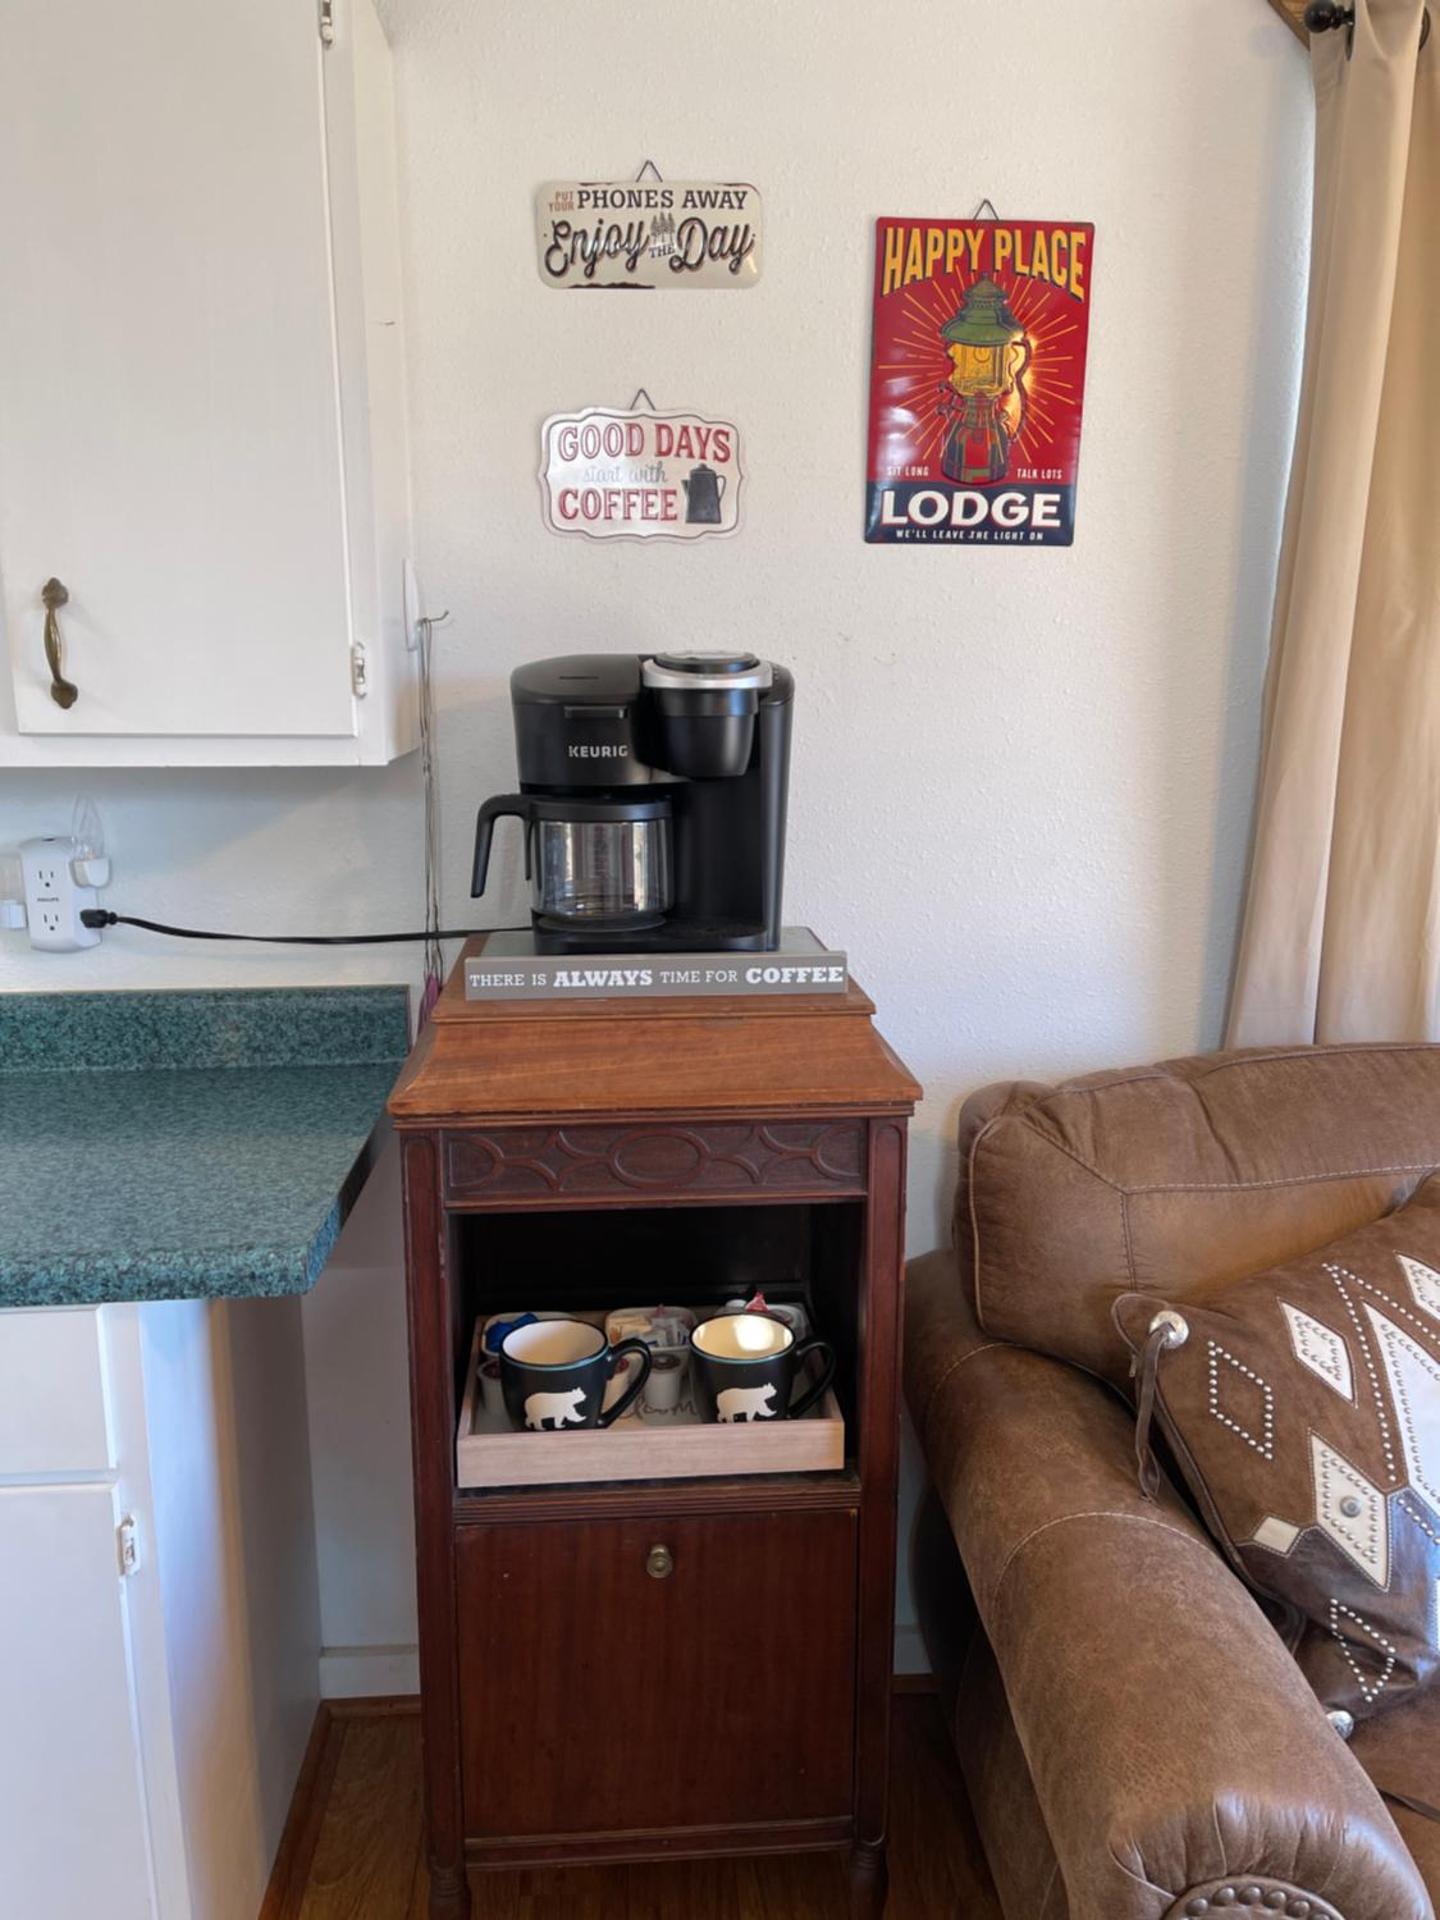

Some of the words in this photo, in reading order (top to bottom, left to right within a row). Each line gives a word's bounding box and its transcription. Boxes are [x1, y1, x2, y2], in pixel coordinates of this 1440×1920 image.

[548, 201, 575, 213] YOUR
[555, 191, 573, 201] PUT
[577, 189, 674, 209] PHONES
[681, 190, 748, 210] AWAY
[544, 218, 650, 279] Enjoy
[650, 245, 676, 258] THE
[668, 217, 756, 275] Day
[882, 226, 985, 297] HAPPY
[992, 228, 1087, 303] PLACE
[558, 422, 645, 462] GOOD
[654, 423, 732, 464] DAYS
[582, 464, 623, 484] start
[628, 461, 669, 484] with
[904, 466, 930, 477] LONG
[1016, 467, 1038, 479] TALK
[1041, 468, 1063, 480] LOTS
[559, 487, 679, 522] COFFEE
[880, 489, 1062, 528] LODGE
[896, 529, 928, 539] WE'LL
[932, 530, 965, 540] LEAVE
[967, 531, 989, 540] THE
[994, 531, 1024, 541] LIGHT
[1029, 532, 1044, 541] ON
[567, 744, 629, 758] KEURIG
[469, 973, 525, 988] THERE
[531, 973, 547, 987] IS
[552, 969, 653, 988] ALWAYS
[659, 970, 701, 984] TIME
[705, 969, 739, 983] FOR
[744, 965, 844, 984] COFFEE
